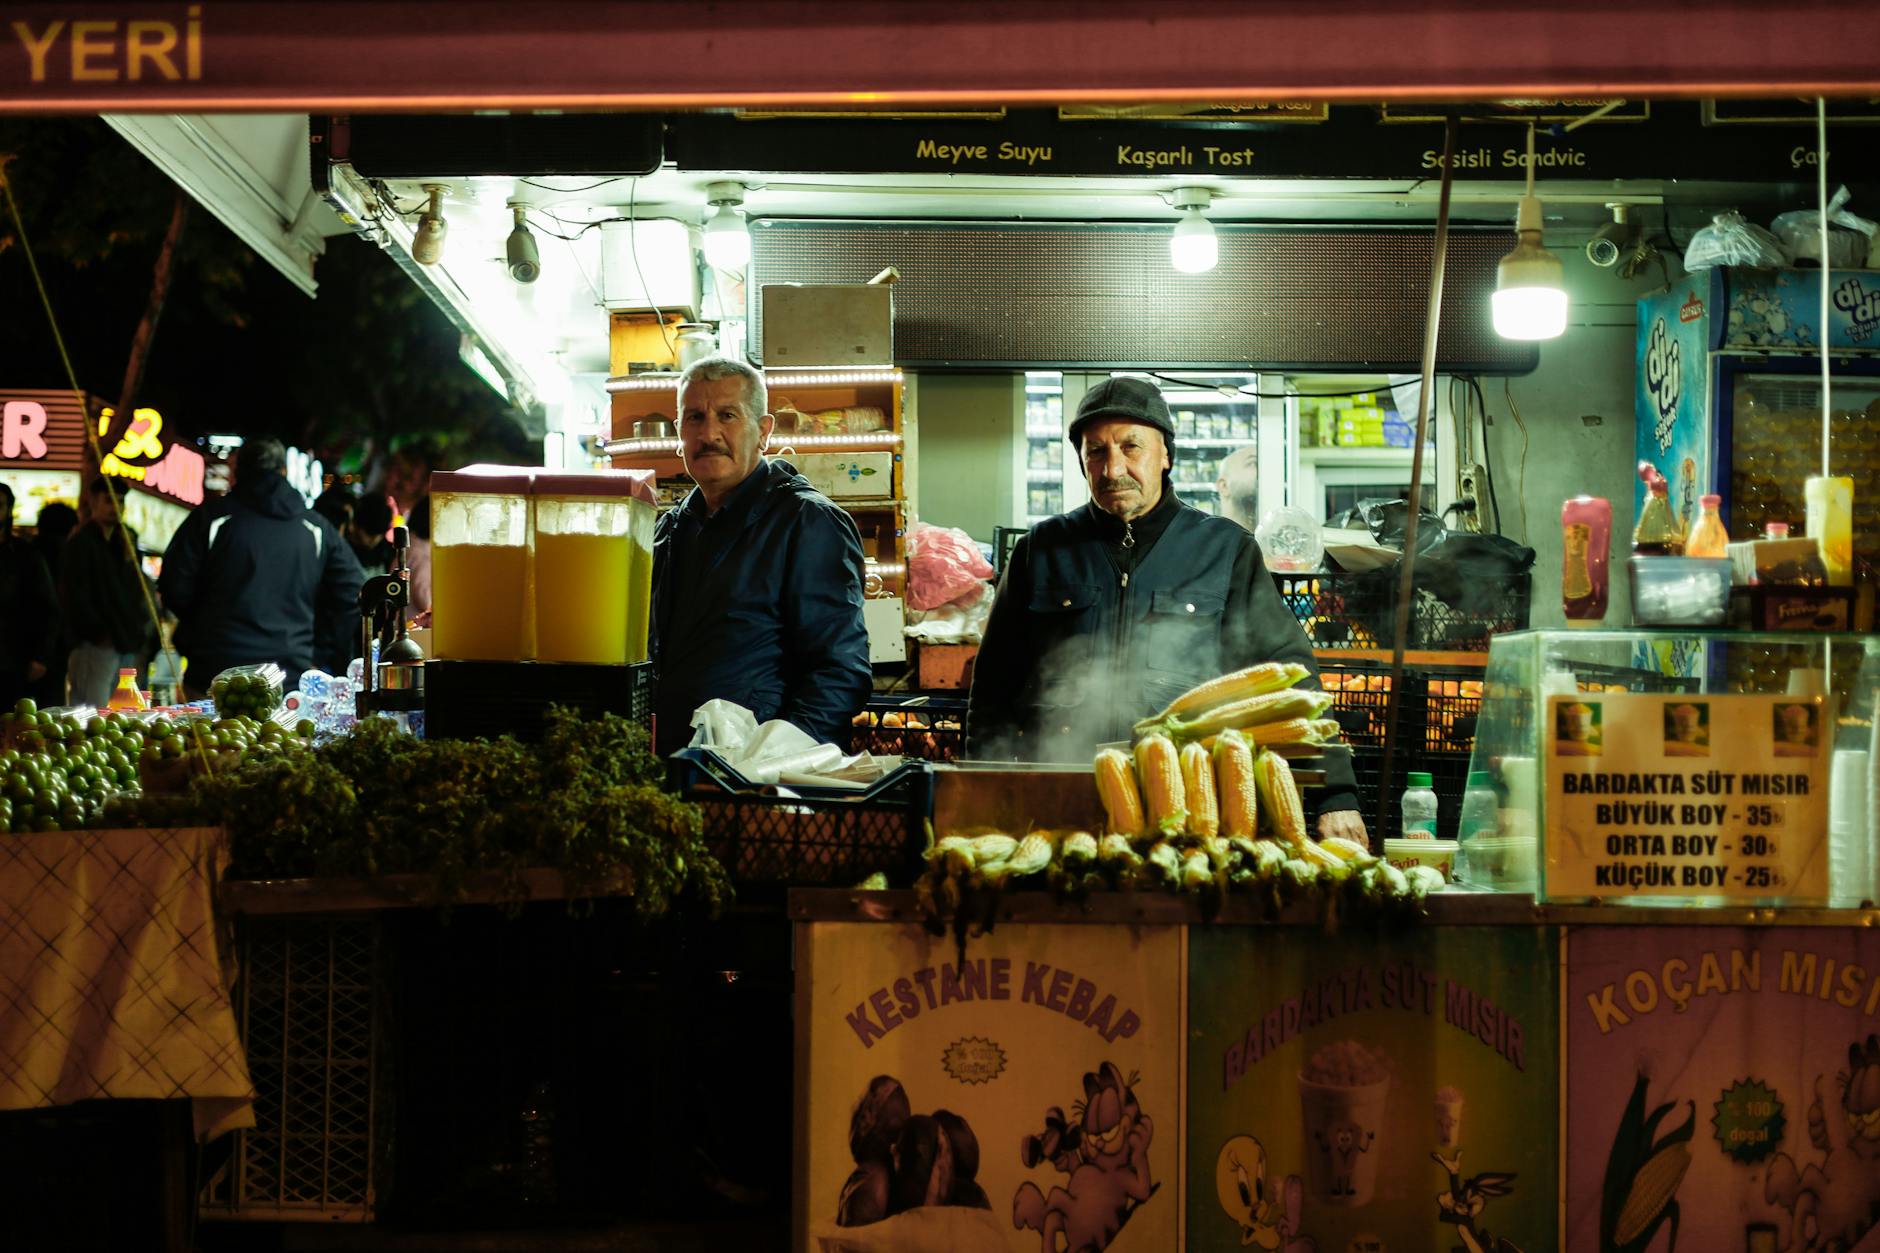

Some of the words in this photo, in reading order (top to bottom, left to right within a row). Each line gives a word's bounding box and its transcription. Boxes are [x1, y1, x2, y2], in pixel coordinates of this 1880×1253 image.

[11, 5, 202, 81] YERİ
[916, 139, 988, 164] Meyve
[998, 143, 1053, 166] Suyu
[1118, 145, 1193, 168] Kaşarlı
[1203, 147, 1255, 166] Tost
[2, 401, 47, 459] R
[1562, 772, 1686, 796] BARDAKTA
[1690, 770, 1737, 796] SÜT
[1741, 773, 1810, 796] MISIR
[1596, 800, 1676, 826] BÜYÜK
[1681, 804, 1727, 826] BOY
[1606, 834, 1667, 857] ORTA
[1671, 835, 1719, 857] BOY
[1595, 861, 1677, 890] KÜÇÜK
[1681, 866, 1729, 888] BOY
[845, 958, 1012, 1050] KESTANE
[1020, 960, 1142, 1044] KEBAP
[1587, 949, 1761, 1034] KOÇAN
[1223, 966, 1372, 1092] BARDAKTA
[1445, 980, 1526, 1073] MISIR
